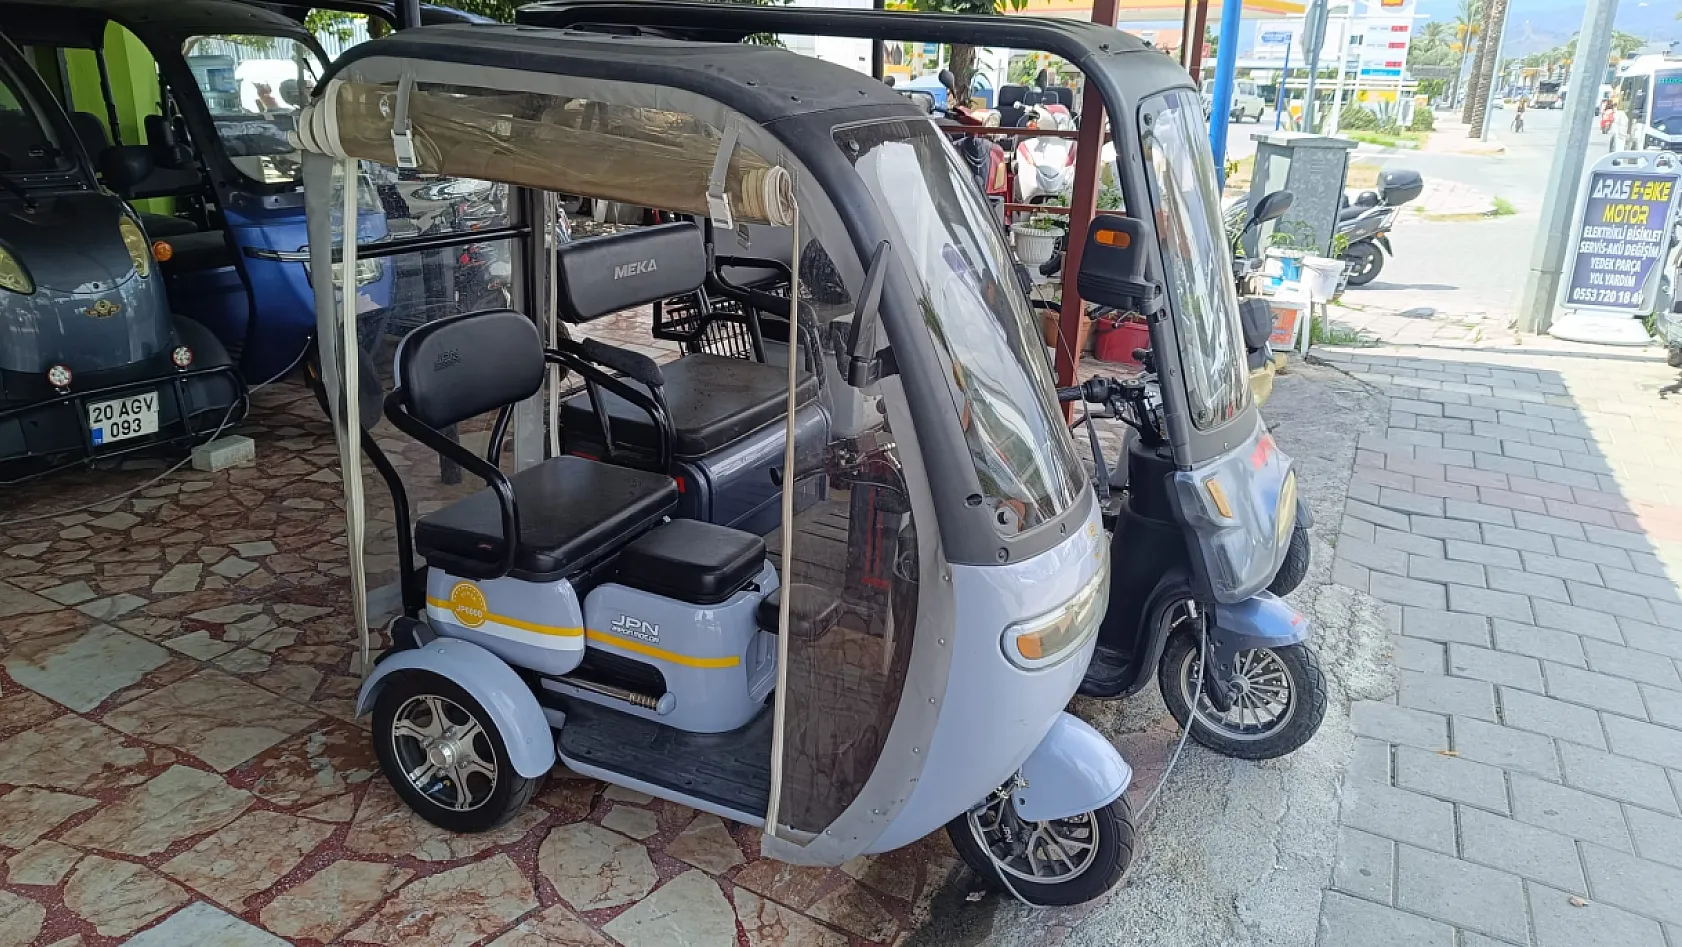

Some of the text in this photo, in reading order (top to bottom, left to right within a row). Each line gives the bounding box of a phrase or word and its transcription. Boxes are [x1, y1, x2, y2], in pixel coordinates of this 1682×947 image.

[1592, 179, 1672, 201] ARAS E-BIKE
[1603, 203, 1649, 225] MOTOR
[614, 258, 657, 280] MEKA
[1590, 257, 1642, 275] YEDEK PARÇA
[1590, 271, 1636, 288] YOL YARDIM
[1573, 287, 1597, 302] 0553
[1598, 289, 1617, 303] 720
[1617, 290, 1631, 304] 18
[92, 396, 154, 423] 20 AGV
[110, 417, 142, 438] 093
[611, 614, 660, 636] JPN
